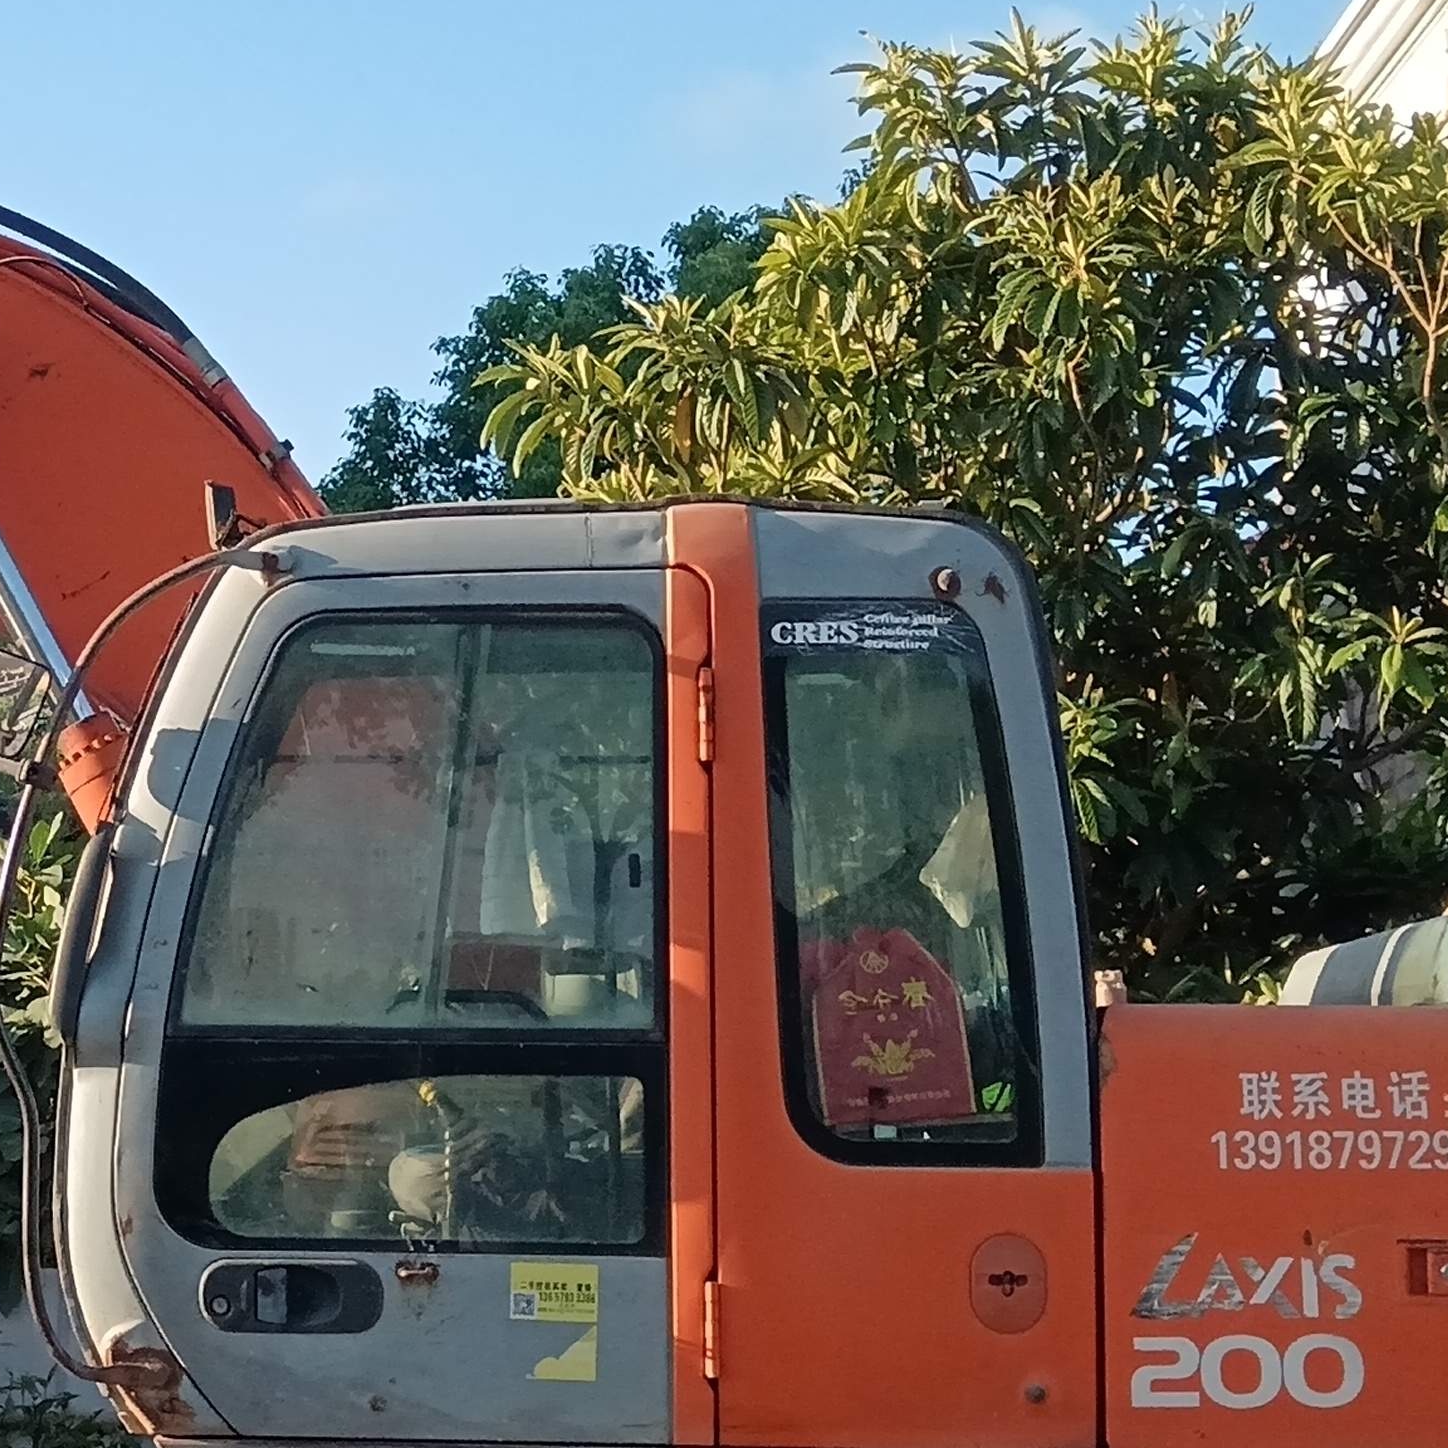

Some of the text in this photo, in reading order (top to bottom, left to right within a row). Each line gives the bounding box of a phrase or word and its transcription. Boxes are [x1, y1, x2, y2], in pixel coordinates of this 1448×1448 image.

[770, 621, 859, 644] CRES
[863, 626, 940, 638] Reinforced
[863, 638, 930, 650] Structure
[1131, 1333, 1365, 1409] 200
